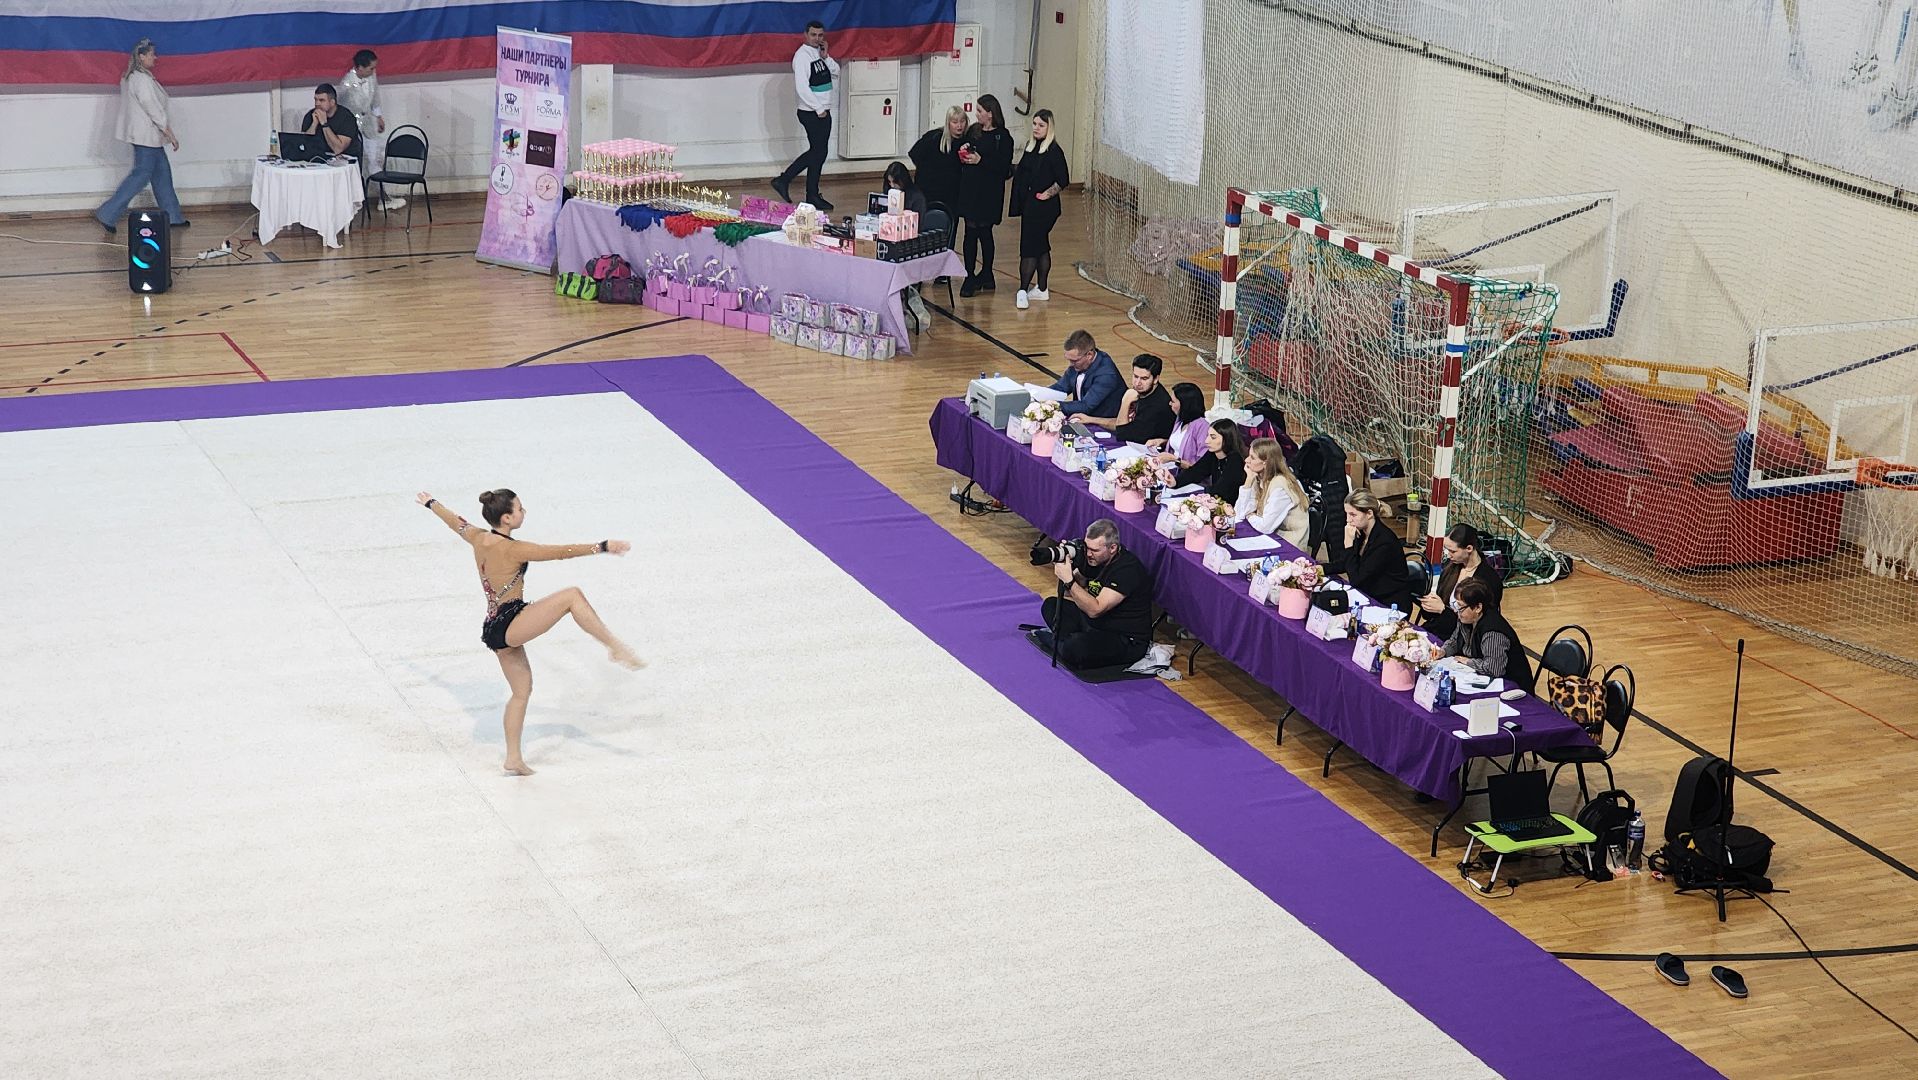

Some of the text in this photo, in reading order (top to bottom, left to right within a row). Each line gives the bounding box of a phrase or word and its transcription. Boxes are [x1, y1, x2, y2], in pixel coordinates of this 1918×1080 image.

[501, 46, 567, 70] НАШИ ПАРТНЕРЫ
[515, 68, 549, 87] ТУРНИРА
[536, 105, 561, 117] FORMA
